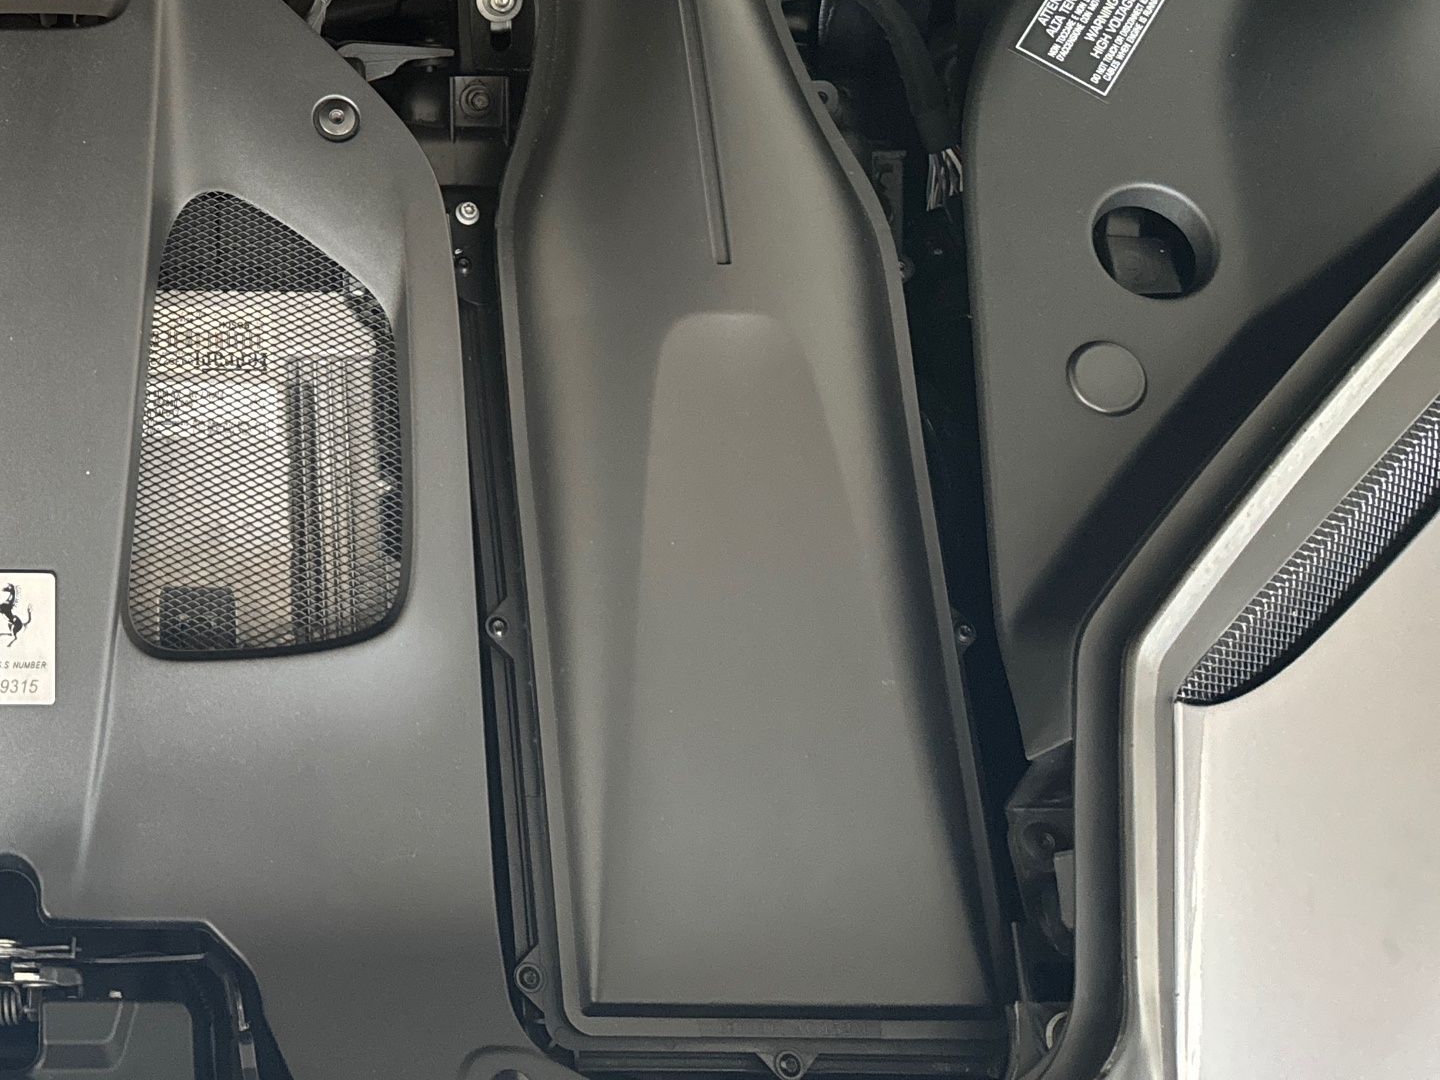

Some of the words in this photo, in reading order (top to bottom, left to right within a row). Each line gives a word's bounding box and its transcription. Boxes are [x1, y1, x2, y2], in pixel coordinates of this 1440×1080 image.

[1046, 15, 1066, 38] ALTA
[1048, 43, 1061, 58] NON
[1056, 19, 1076, 46] TOCCARE
[1074, 2, 1088, 16] NON
[1056, 23, 1085, 61] D'ACCENSIONE
[1080, 10, 1093, 24] CON
[1091, 33, 1112, 59] HIGH
[1096, 61, 1108, 77] NOT
[1103, 43, 1120, 65] TOUCH
[1119, 3, 1144, 39] DISCONNECT
[1103, 60, 1121, 82] CABLES
[1116, 42, 1131, 61] WHEN
[1126, 22, 1144, 44] ENGINE
[12, 660, 48, 670] NUMBER
